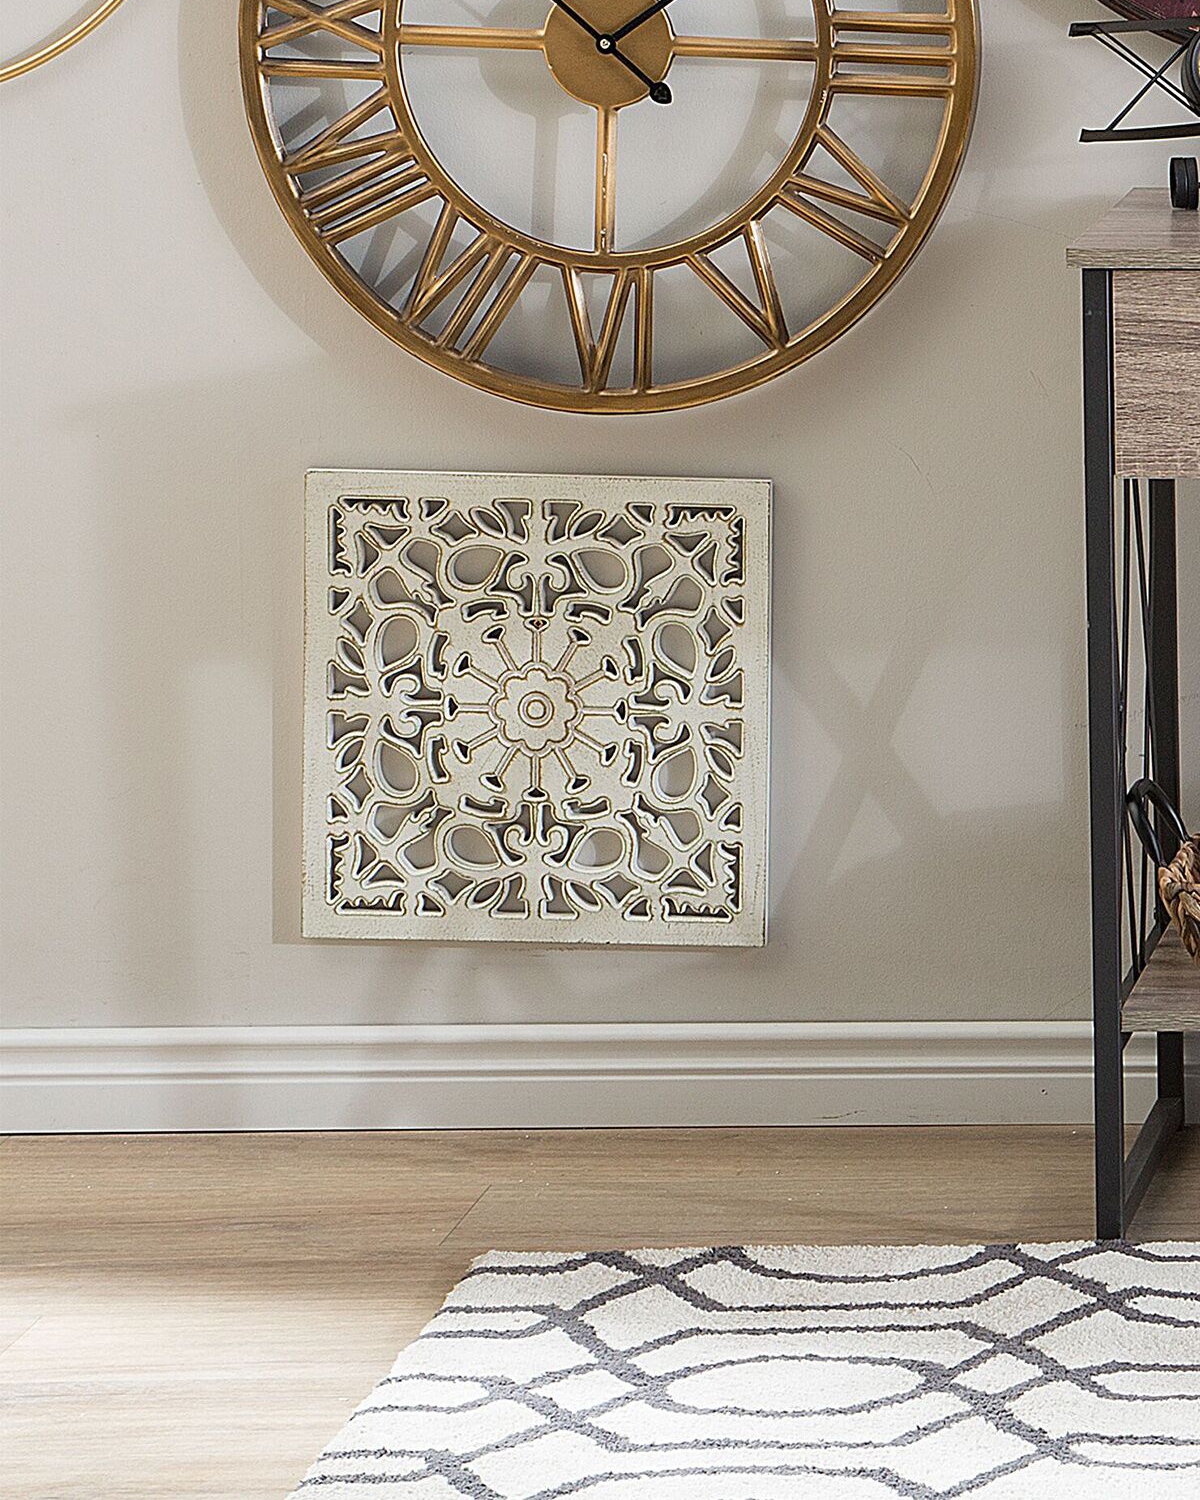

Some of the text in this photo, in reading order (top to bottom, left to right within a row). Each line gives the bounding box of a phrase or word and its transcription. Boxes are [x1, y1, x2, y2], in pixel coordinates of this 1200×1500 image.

[829, 10, 956, 98] III
[282, 84, 446, 246] VIII
[402, 203, 538, 360] VII
[560, 263, 654, 393] VI
